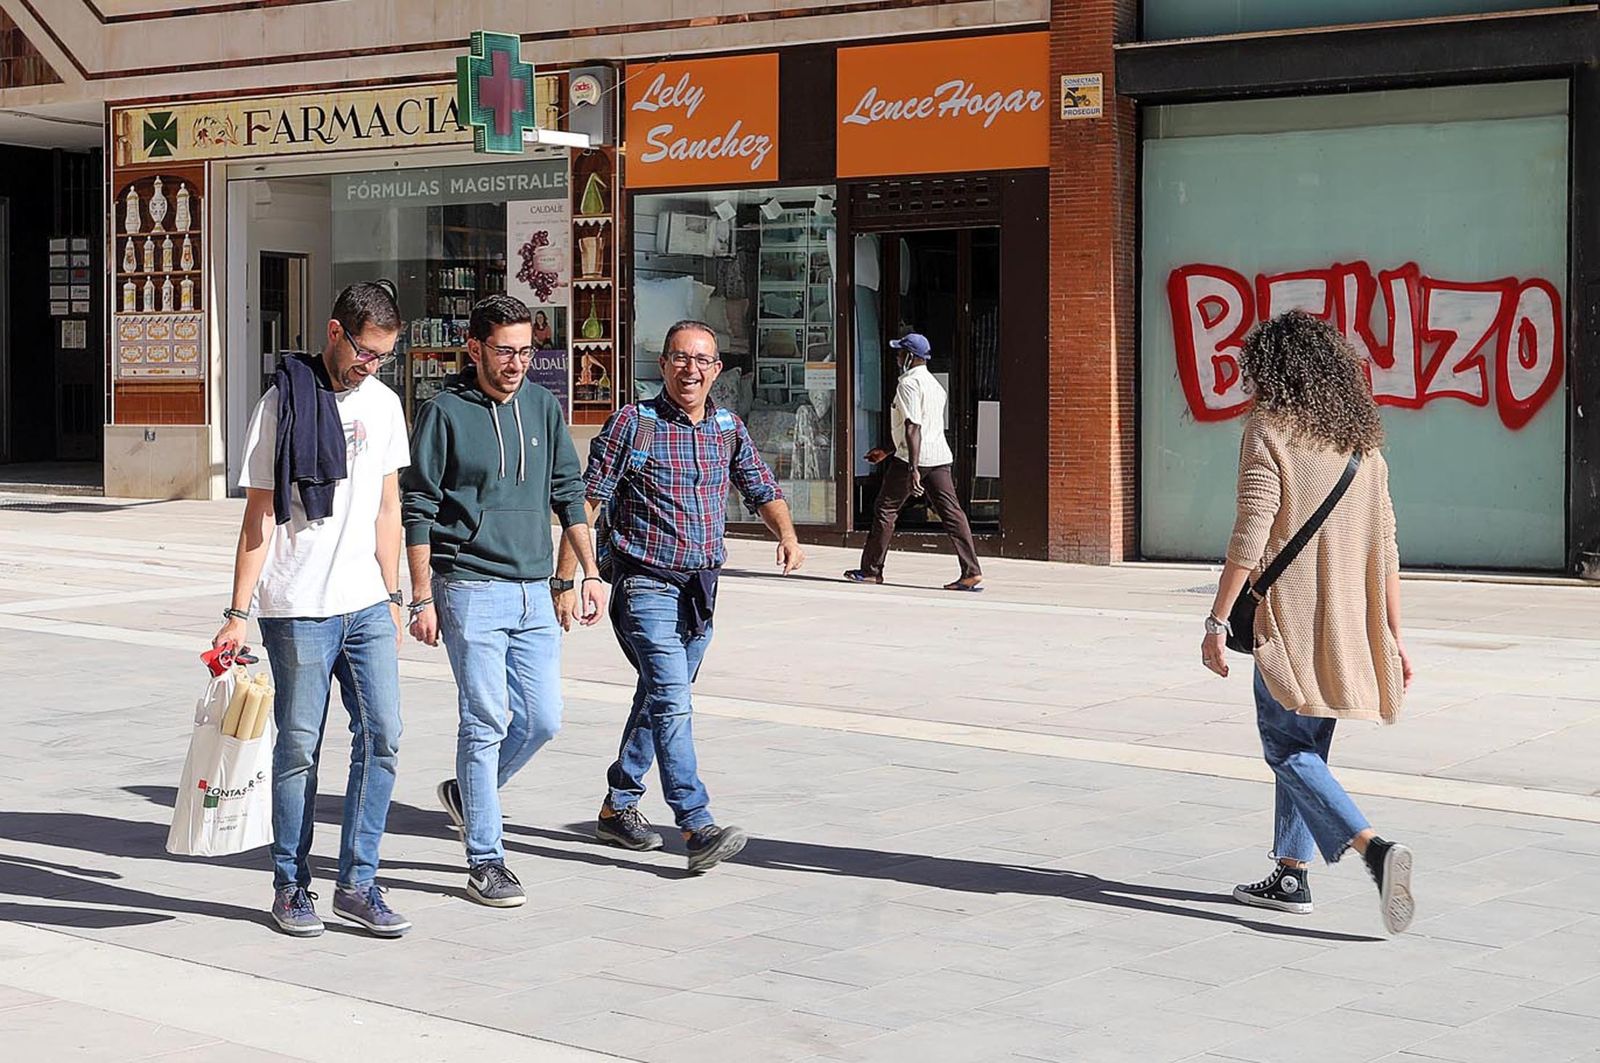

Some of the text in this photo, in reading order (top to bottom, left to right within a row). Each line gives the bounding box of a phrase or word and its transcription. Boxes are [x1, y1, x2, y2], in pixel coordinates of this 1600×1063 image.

[631, 72, 705, 119] Lely
[1063, 108, 1101, 116] PROSEGUR
[243, 97, 467, 146] FARMACIA
[640, 119, 773, 171] Sanchez
[347, 180, 440, 200] FÓRMULAS
